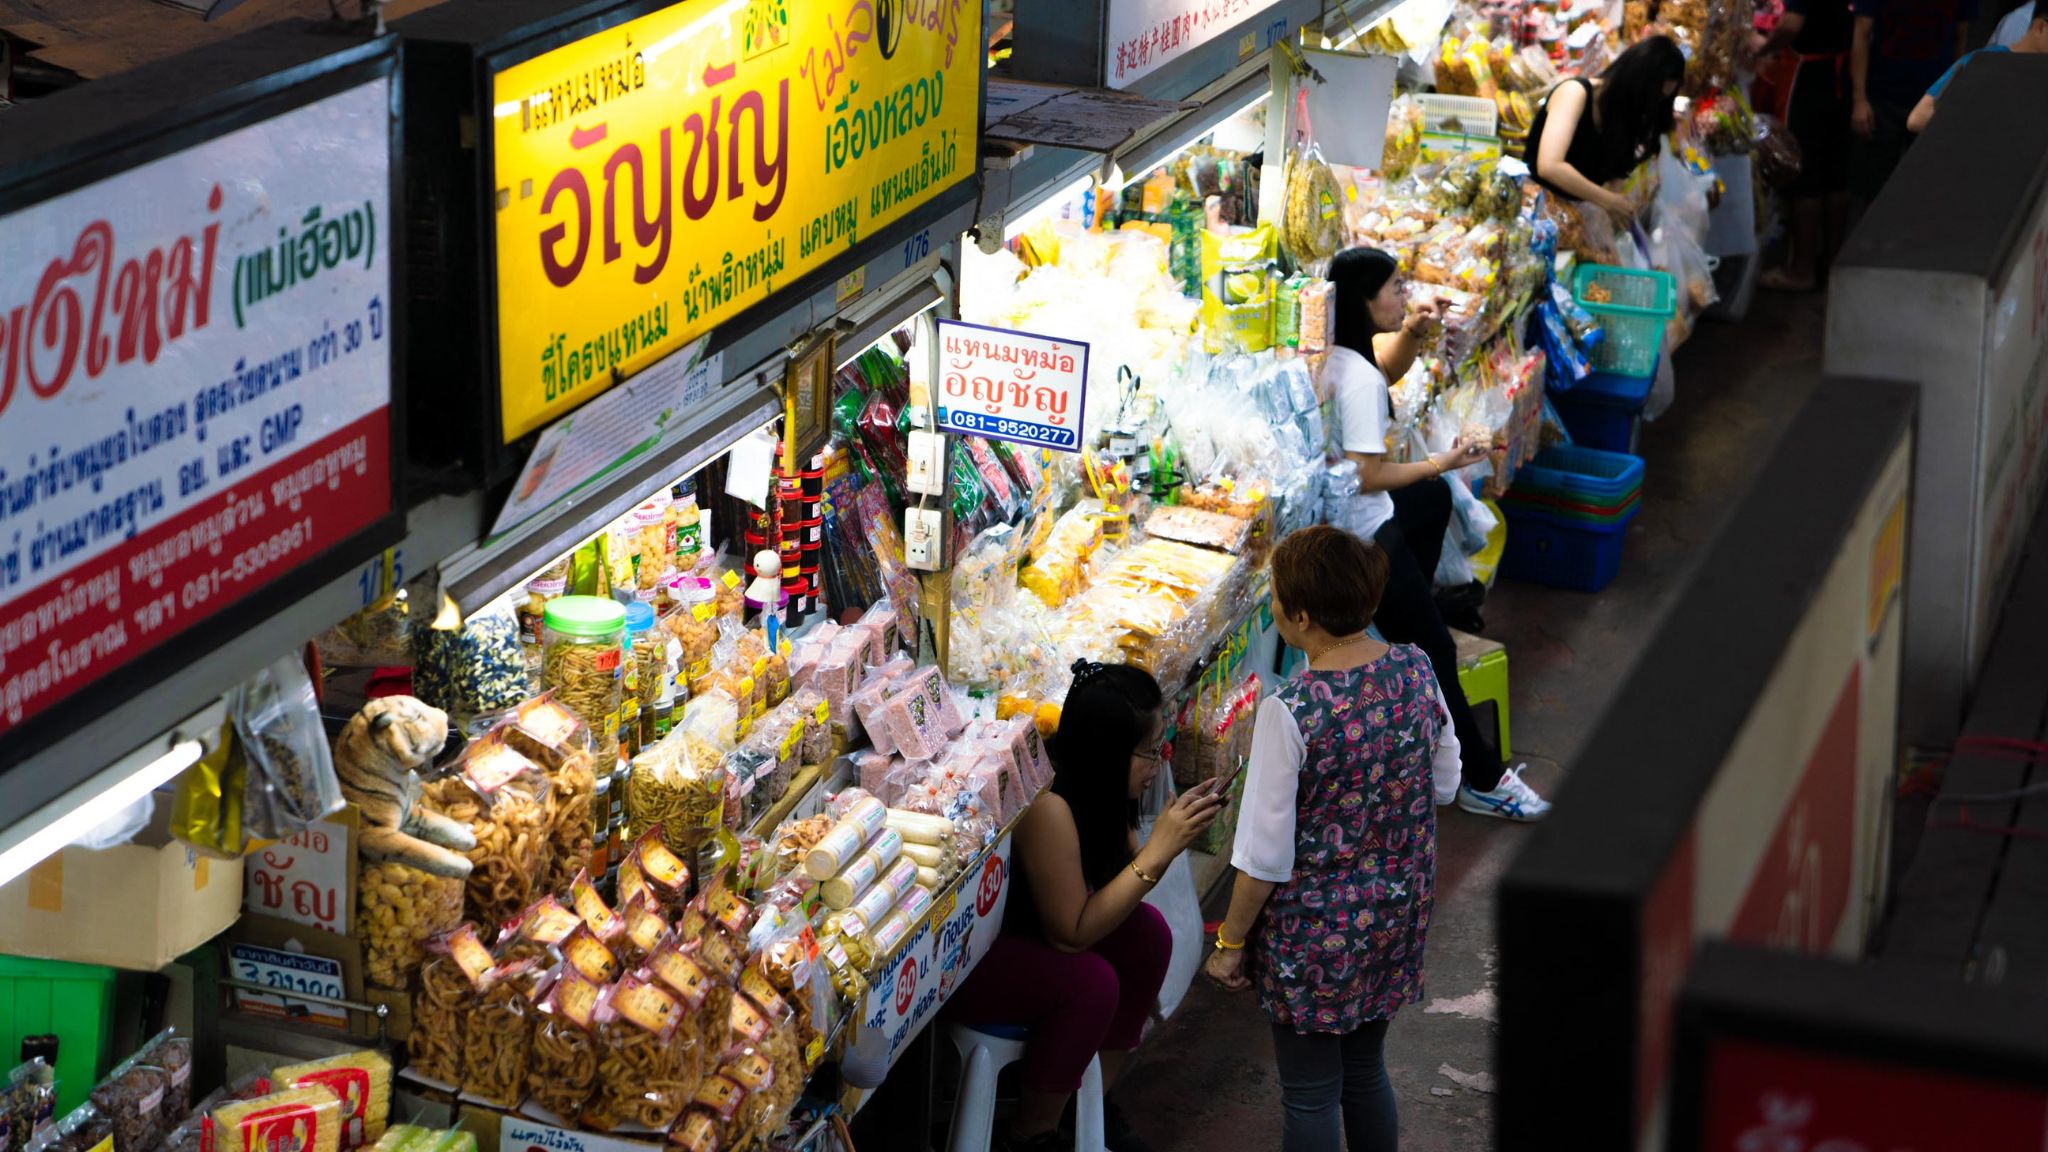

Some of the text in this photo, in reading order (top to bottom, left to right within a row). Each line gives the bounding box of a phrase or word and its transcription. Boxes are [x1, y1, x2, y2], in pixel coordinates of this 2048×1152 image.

[825, 70, 943, 174] เอื้องหลวง
[540, 62, 790, 287] อัญชัญ
[683, 228, 785, 325] น้ำพริกหนุ่ม
[800, 196, 858, 259] แคบหมู
[871, 128, 956, 218] แหนมเอ็นไก่
[904, 229, 929, 269] 1/76
[308, 320, 338, 371] กว่า
[344, 319, 362, 354] 30
[367, 295, 382, 342] ปี
[946, 335, 1075, 374] แหนมหม้อ
[945, 357, 1068, 426] อัญชัญ
[217, 435, 252, 477] และ
[260, 403, 303, 454] GMP
[954, 411, 1071, 444] 081-9520277
[358, 550, 403, 604] 1/5
[0, 619, 128, 725] สูตรโบราณ
[979, 864, 1001, 910] 130
[898, 965, 916, 1006] 80
